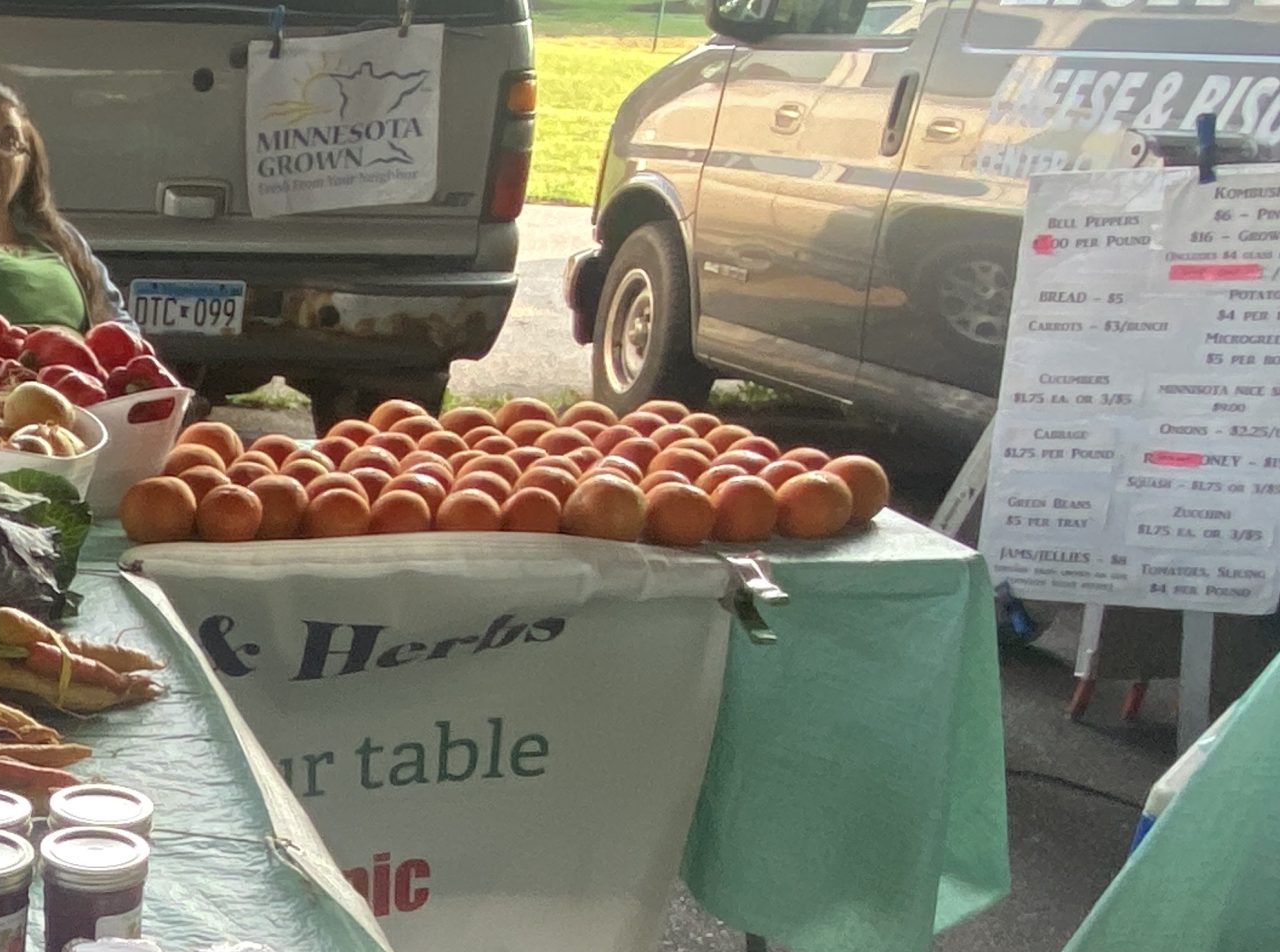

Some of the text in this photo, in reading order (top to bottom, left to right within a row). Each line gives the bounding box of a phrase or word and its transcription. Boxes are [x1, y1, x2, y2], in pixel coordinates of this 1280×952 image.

[1131, 71, 1183, 130] &
[257, 118, 424, 153] MINNESOTA
[257, 147, 365, 177] GROWN
[1085, 215, 1140, 228] PEPPERS
[1214, 209, 1232, 222] $6
[1075, 238, 1099, 249] PER
[1106, 235, 1152, 248] POUND
[1190, 230, 1214, 243] $16
[1039, 291, 1087, 303] BREAD
[1107, 292, 1124, 304] $5
[194, 299, 236, 326] 099
[1216, 309, 1235, 321] $4
[1243, 311, 1269, 321] PER
[1028, 320, 1083, 332] CARROTS
[1206, 352, 1224, 365] $5
[1231, 355, 1256, 365] PER
[1039, 373, 1110, 385] CUCUMBERS
[1076, 394, 1093, 404] OR
[1033, 428, 1089, 440] CABBAGE
[1159, 423, 1208, 436] ONIONS
[1041, 449, 1064, 459] PER
[1071, 447, 1115, 460] POUND
[1127, 476, 1172, 489] SQUASH
[1007, 497, 1091, 509] GREEN BEANS
[1172, 506, 1231, 520] ZUCCHINI
[1006, 515, 1089, 528] $5 PER TRAY
[1203, 529, 1221, 538] OR
[999, 547, 1091, 563] JAMS/JELLIES
[1173, 585, 1198, 596] PER
[1206, 585, 1251, 598] POUND
[199, 614, 566, 681] & Herbs
[355, 717, 549, 790] table
